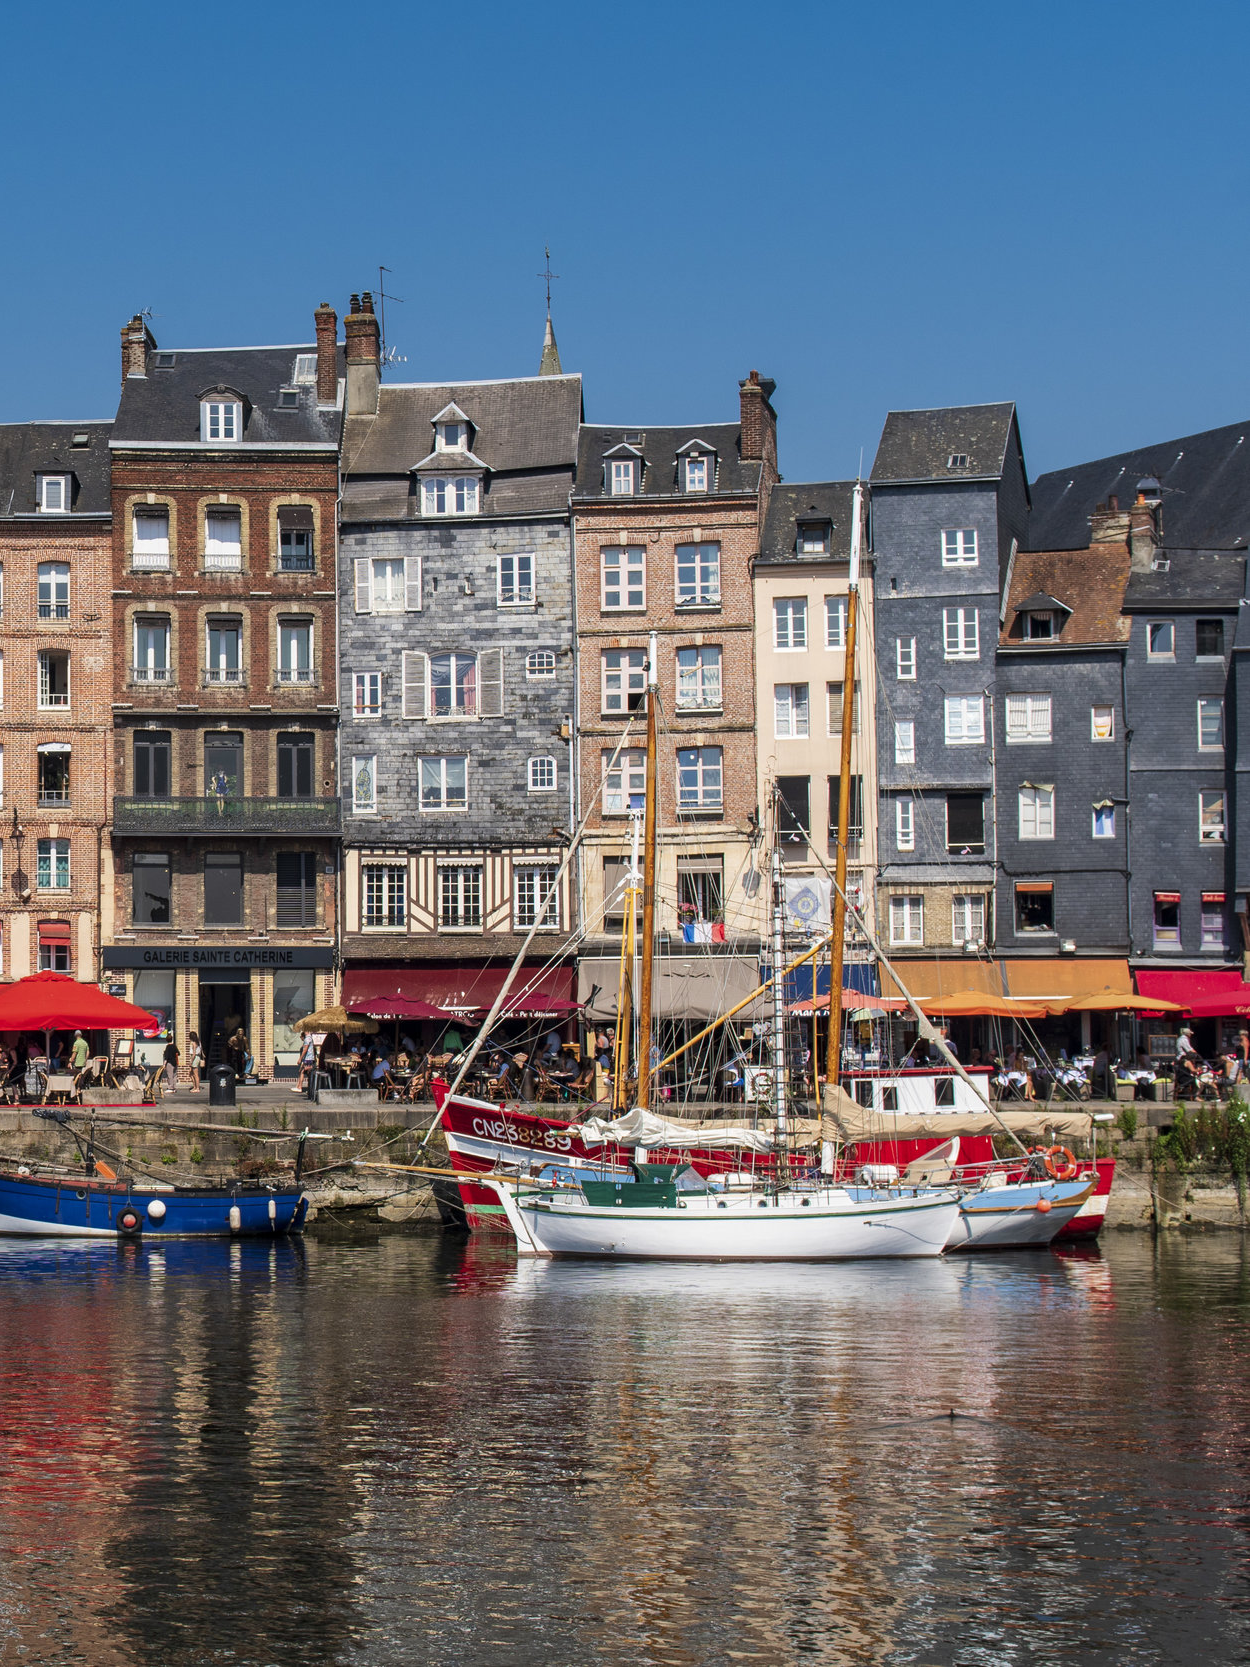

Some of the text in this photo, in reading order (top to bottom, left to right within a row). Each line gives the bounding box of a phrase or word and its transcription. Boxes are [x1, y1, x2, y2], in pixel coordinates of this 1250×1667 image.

[143, 951, 293, 963] GALERIE SAINTE CATHERINE
